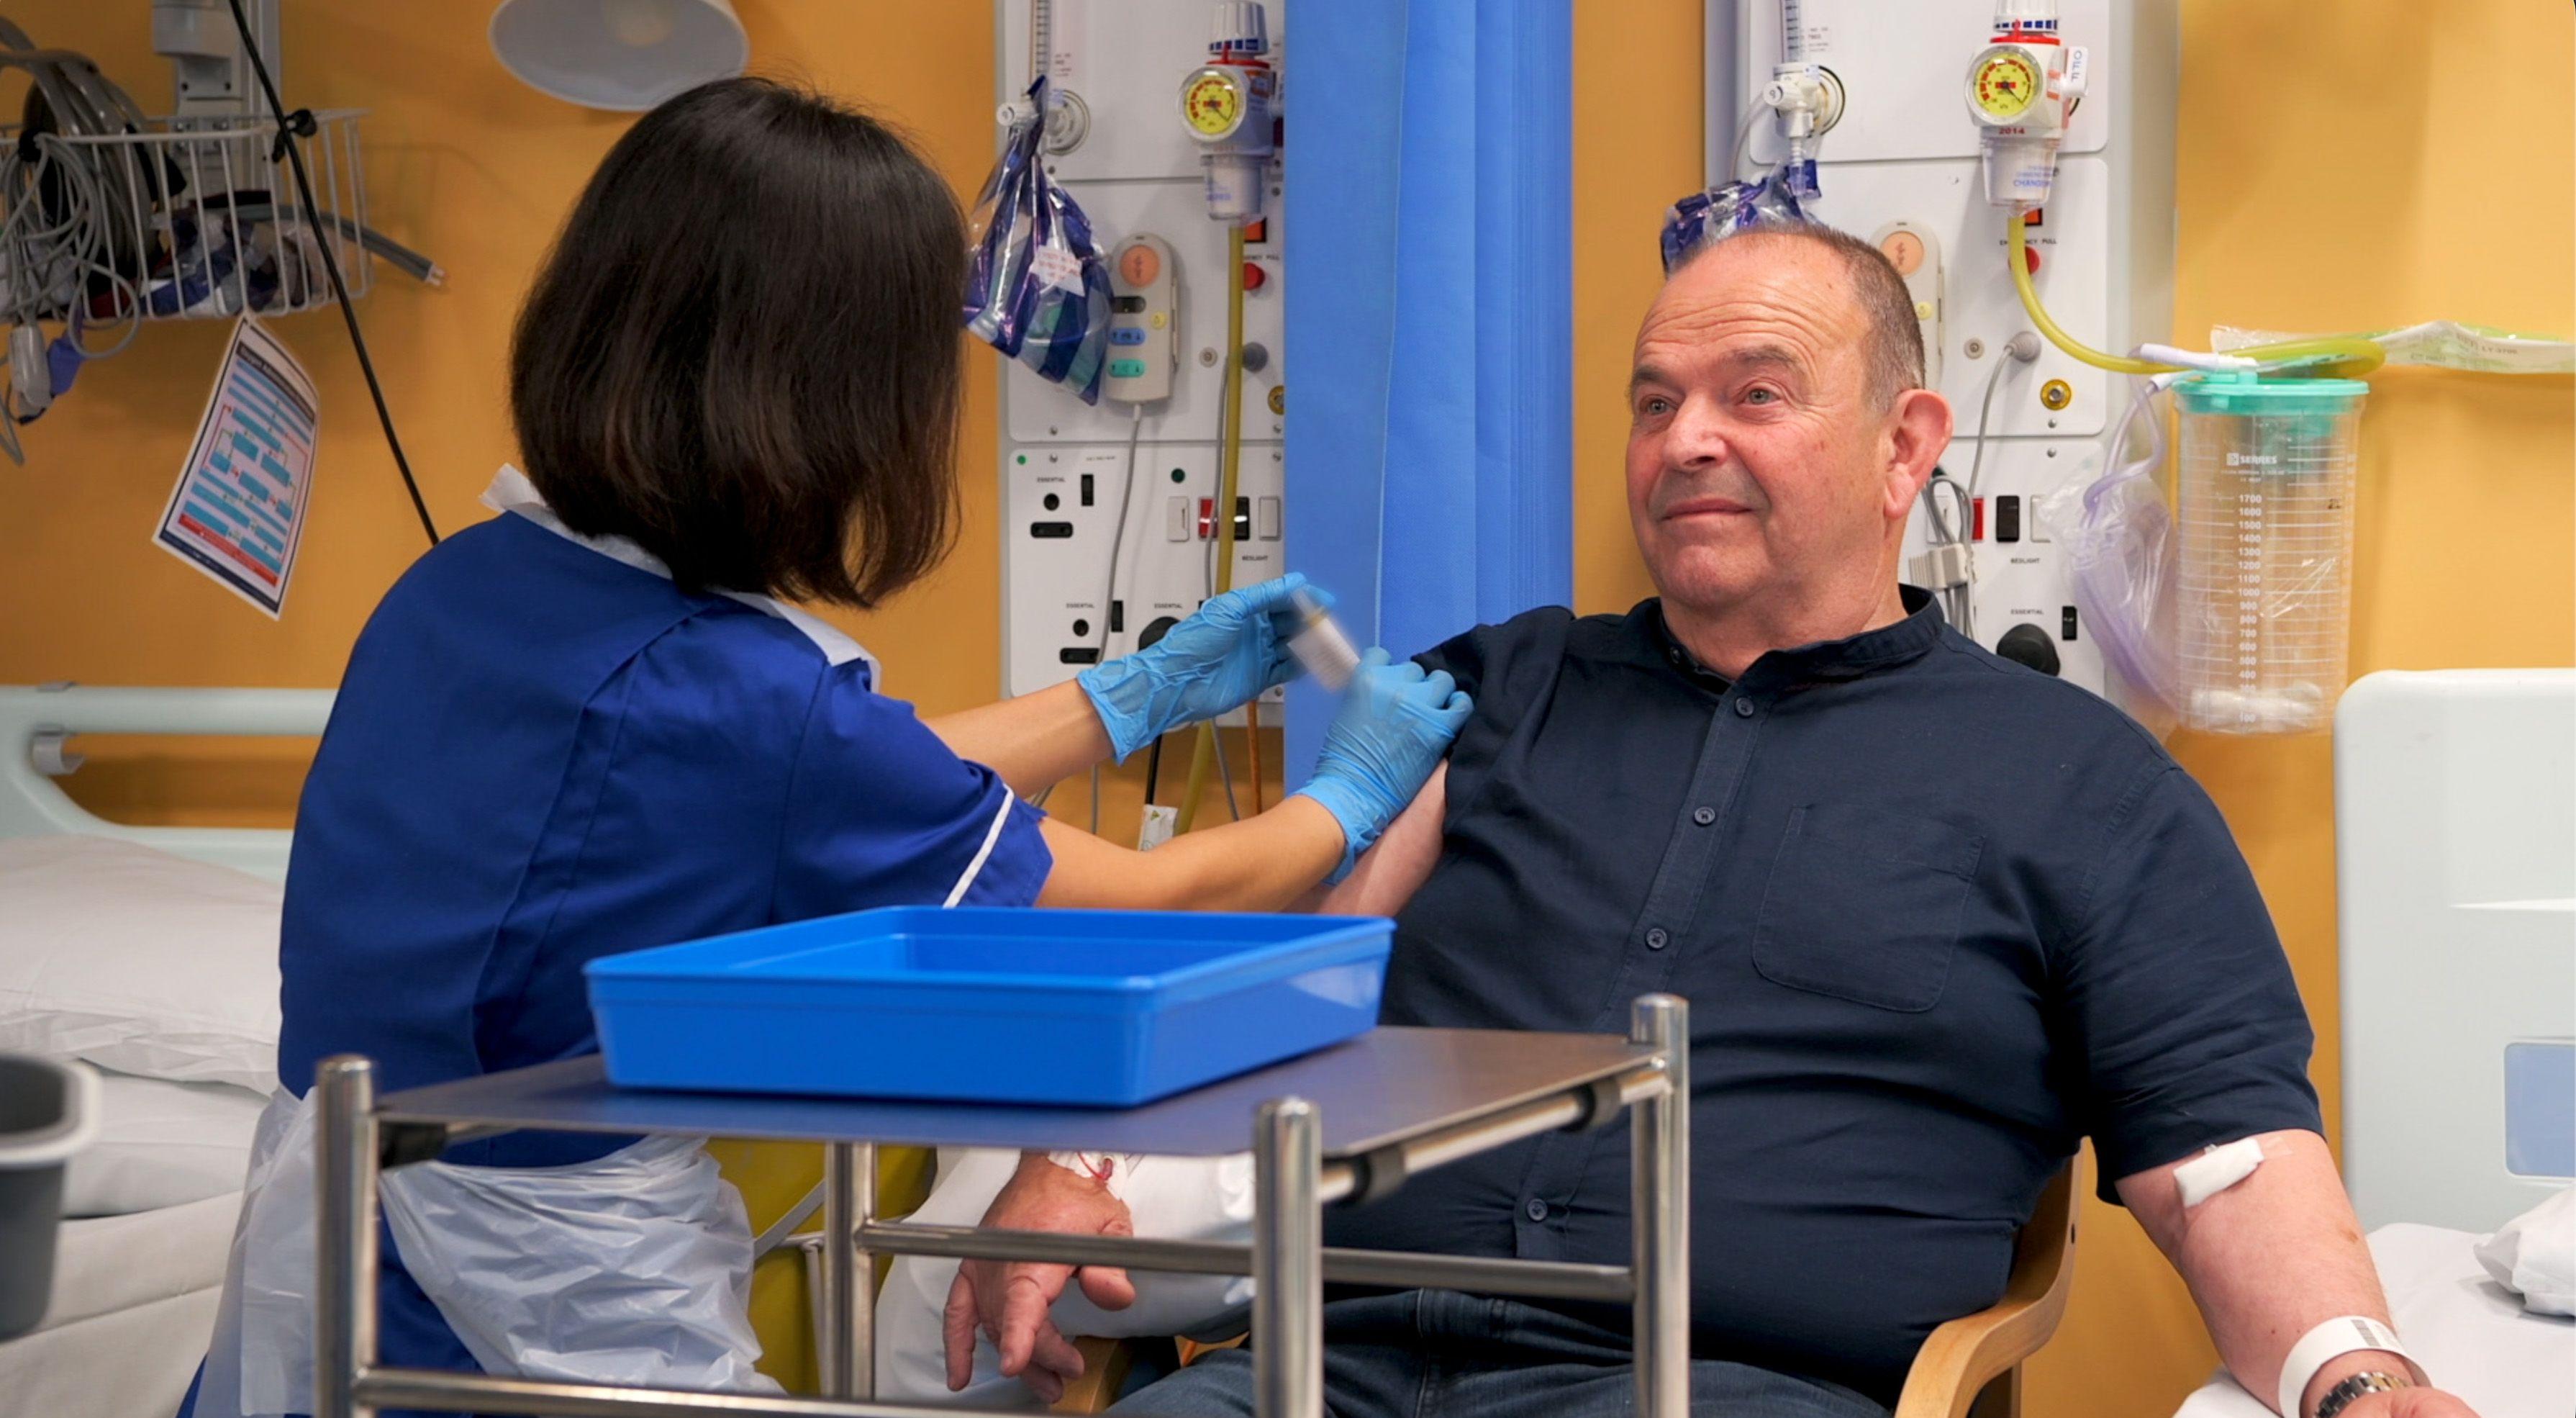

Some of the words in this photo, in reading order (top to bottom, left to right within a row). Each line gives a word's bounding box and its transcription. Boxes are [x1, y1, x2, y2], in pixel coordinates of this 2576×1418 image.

[2240, 456, 2277, 465] SERRES
[2239, 495, 2262, 503] 1700
[2239, 507, 2262, 516] 1600
[2239, 521, 2261, 530] 1500
[2239, 534, 2261, 543] 1400
[2239, 548, 2261, 556] 1300
[2239, 574, 2261, 583] 1100
[2239, 588, 2260, 597] 1000
[2240, 602, 2257, 610] 900
[2240, 615, 2257, 624] 800
[2240, 628, 2257, 638] 700
[2239, 642, 2257, 651] 600
[2239, 656, 2257, 665] 500
[2239, 670, 2257, 679] 400
